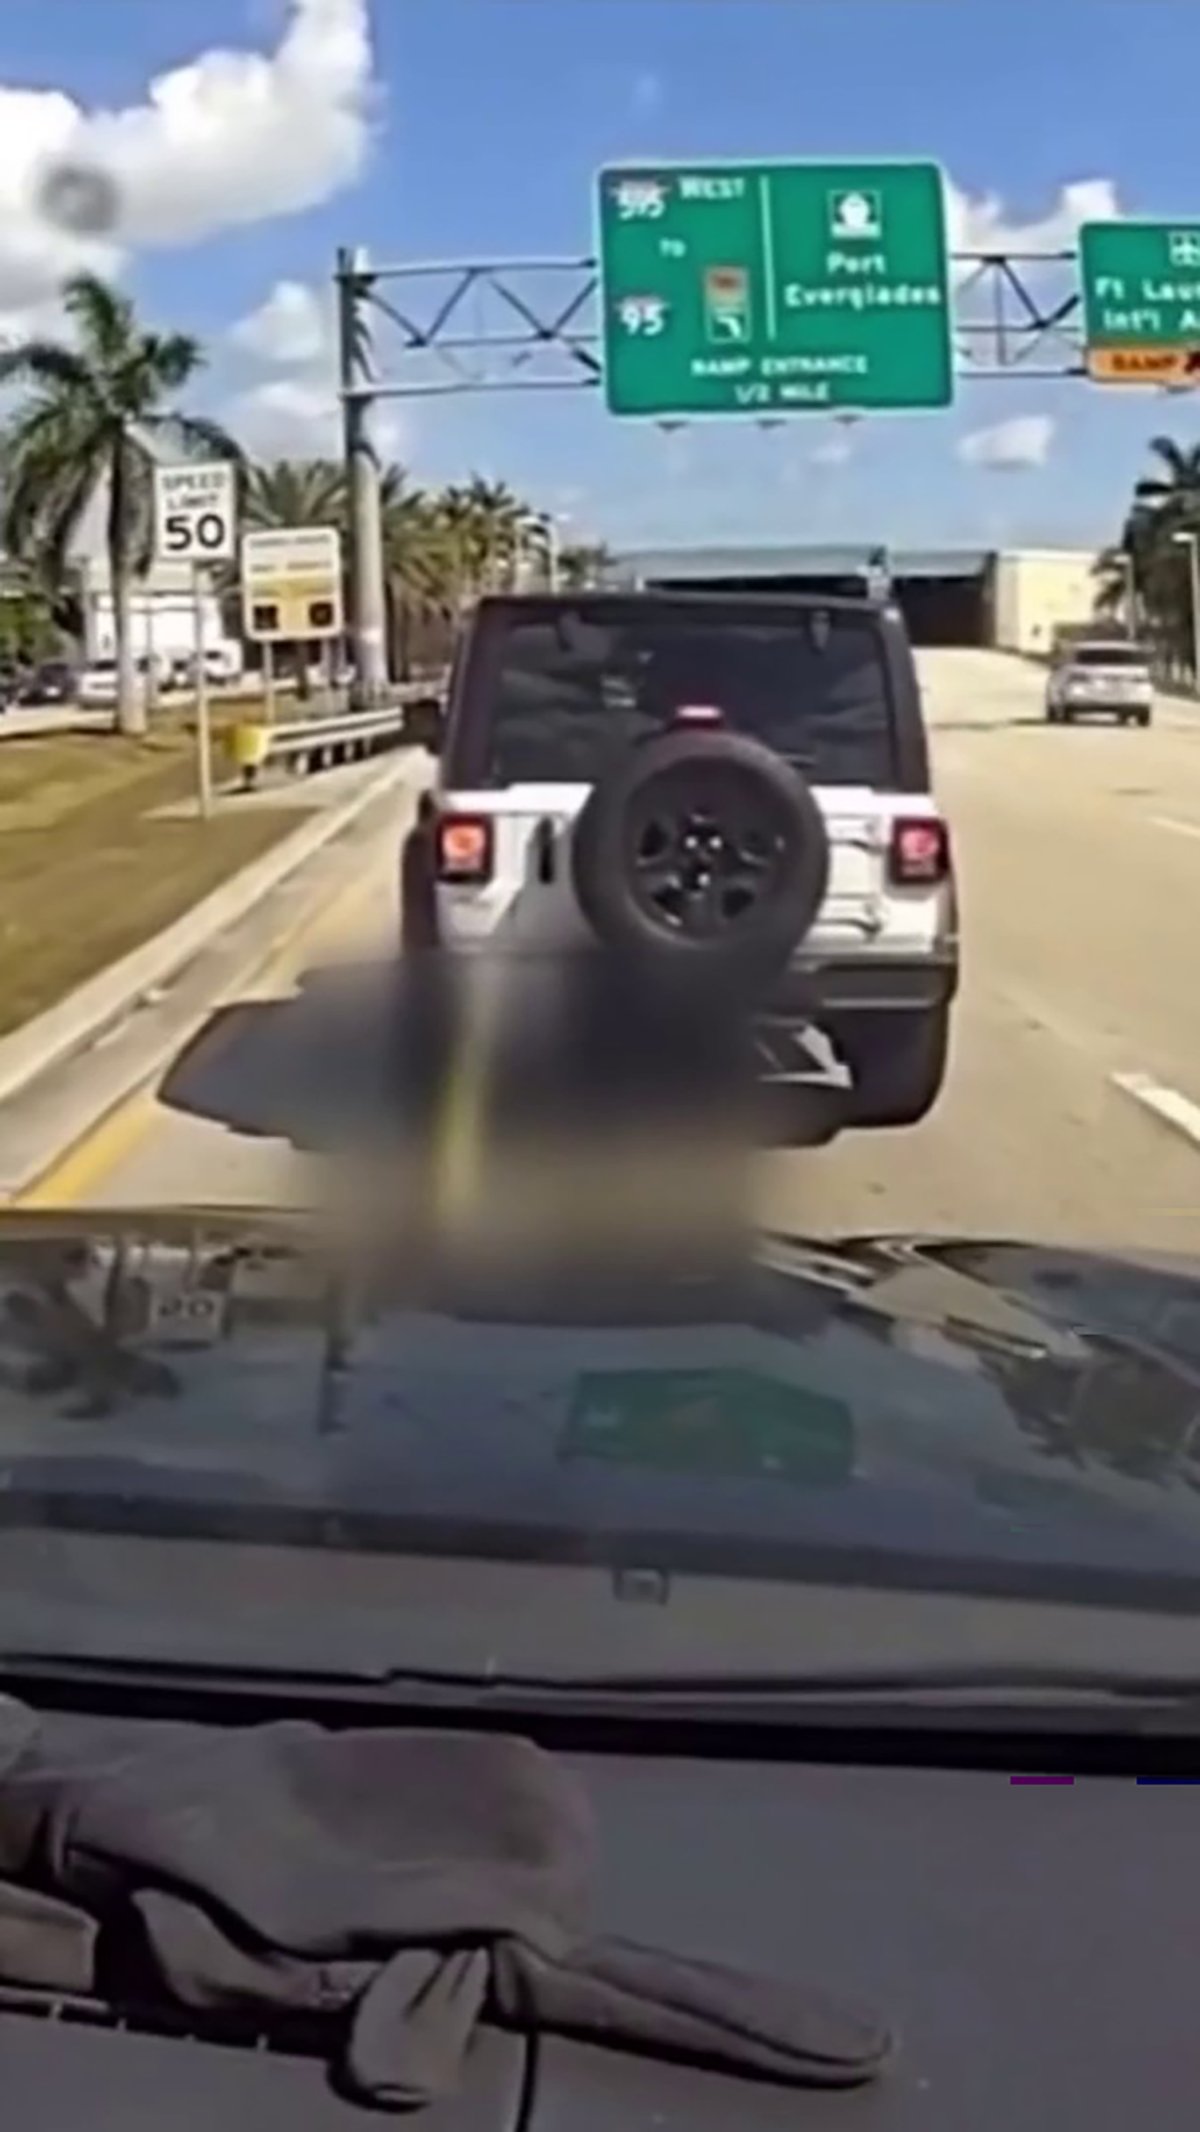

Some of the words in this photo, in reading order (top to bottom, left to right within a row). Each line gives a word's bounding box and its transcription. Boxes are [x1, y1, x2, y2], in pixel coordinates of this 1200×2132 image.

[679, 176, 745, 199] WEST
[826, 252, 886, 275] Port
[784, 284, 941, 312] Everglades
[620, 300, 665, 336] 95
[691, 356, 752, 377] RAMP
[761, 355, 868, 377] ENTRANCE
[779, 381, 830, 401] MILE
[162, 471, 225, 490] SPEED
[167, 493, 219, 510] LIMIT
[165, 513, 225, 551] 50
